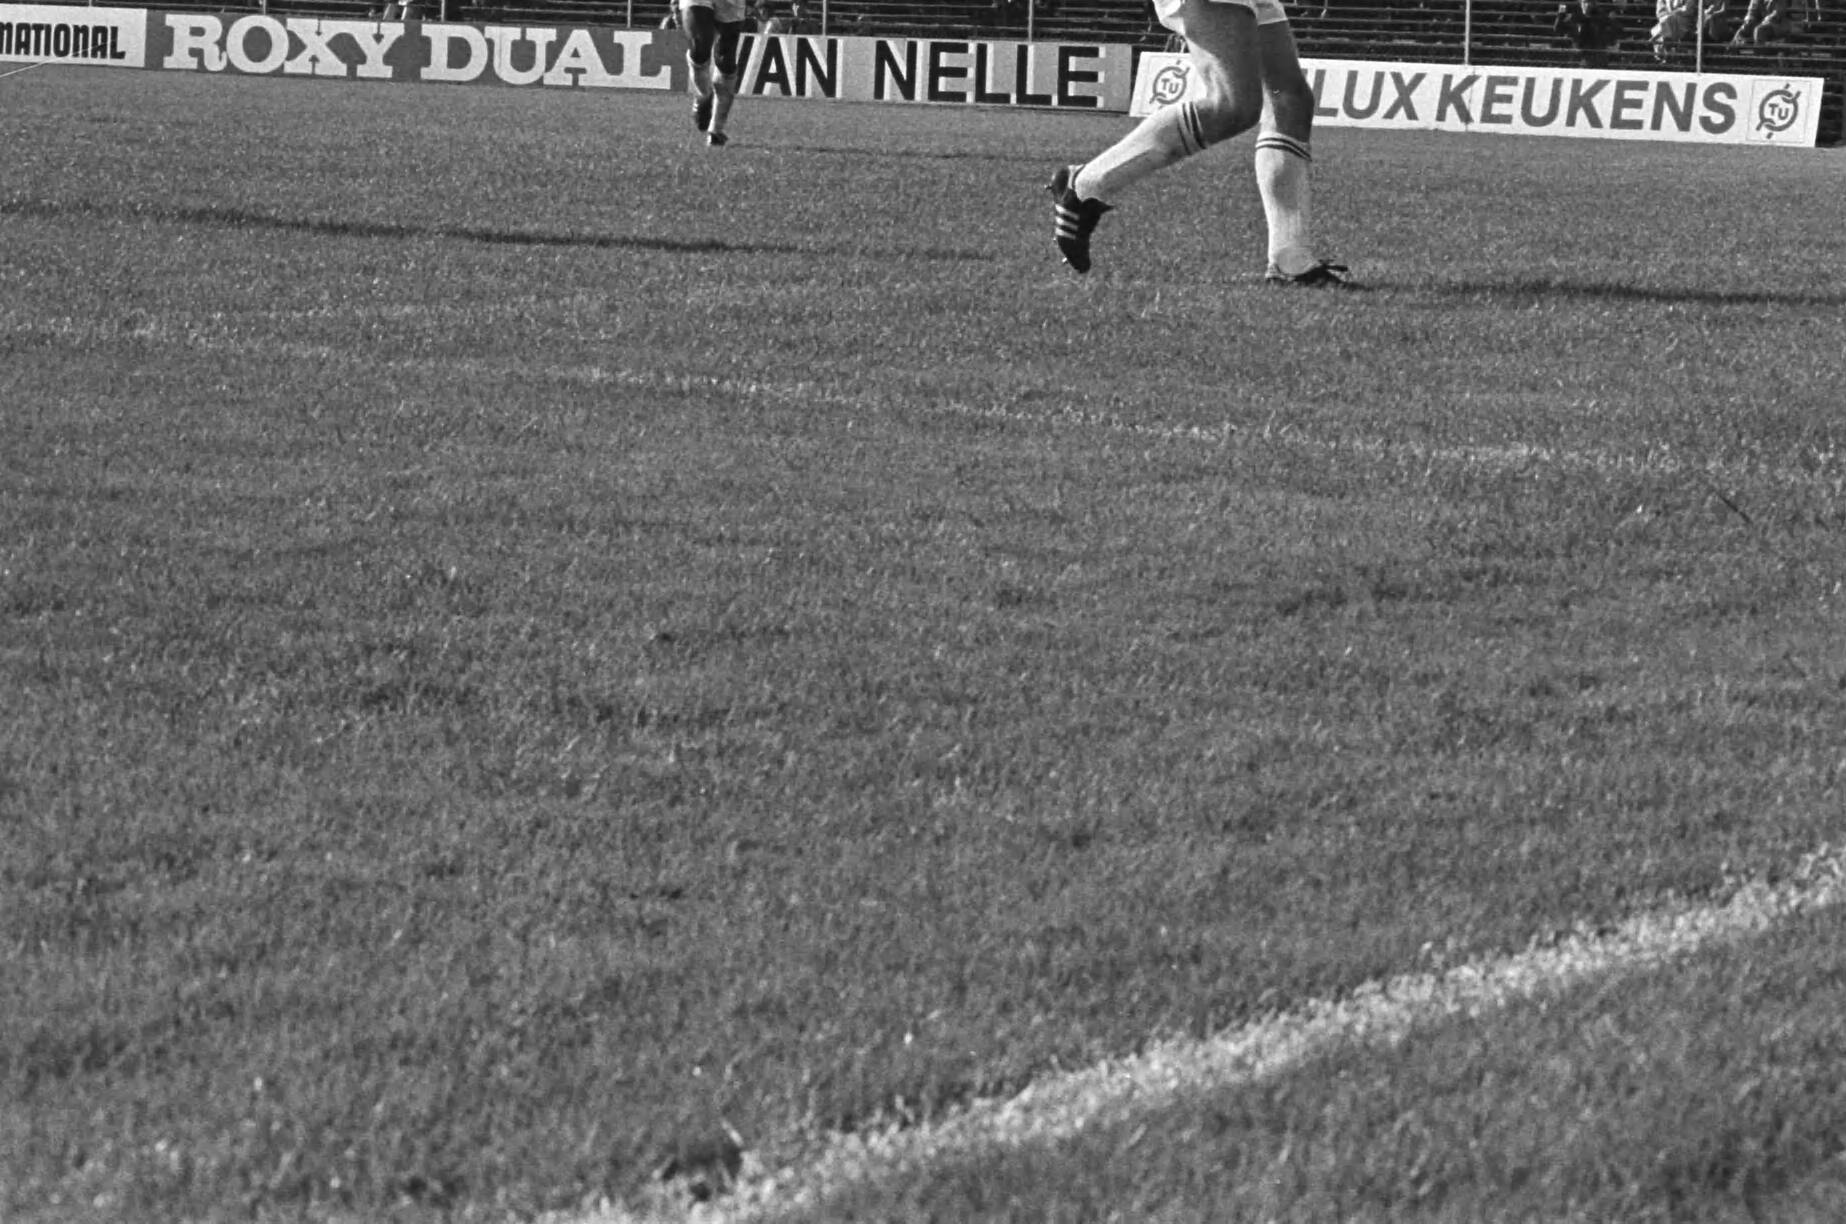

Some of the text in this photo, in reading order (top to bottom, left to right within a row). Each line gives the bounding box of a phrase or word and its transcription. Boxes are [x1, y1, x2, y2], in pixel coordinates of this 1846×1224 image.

[164, 14, 671, 90] ROXY DUAL
[874, 40, 1105, 107] NELLE
[1436, 73, 1738, 134] KEUKENS
